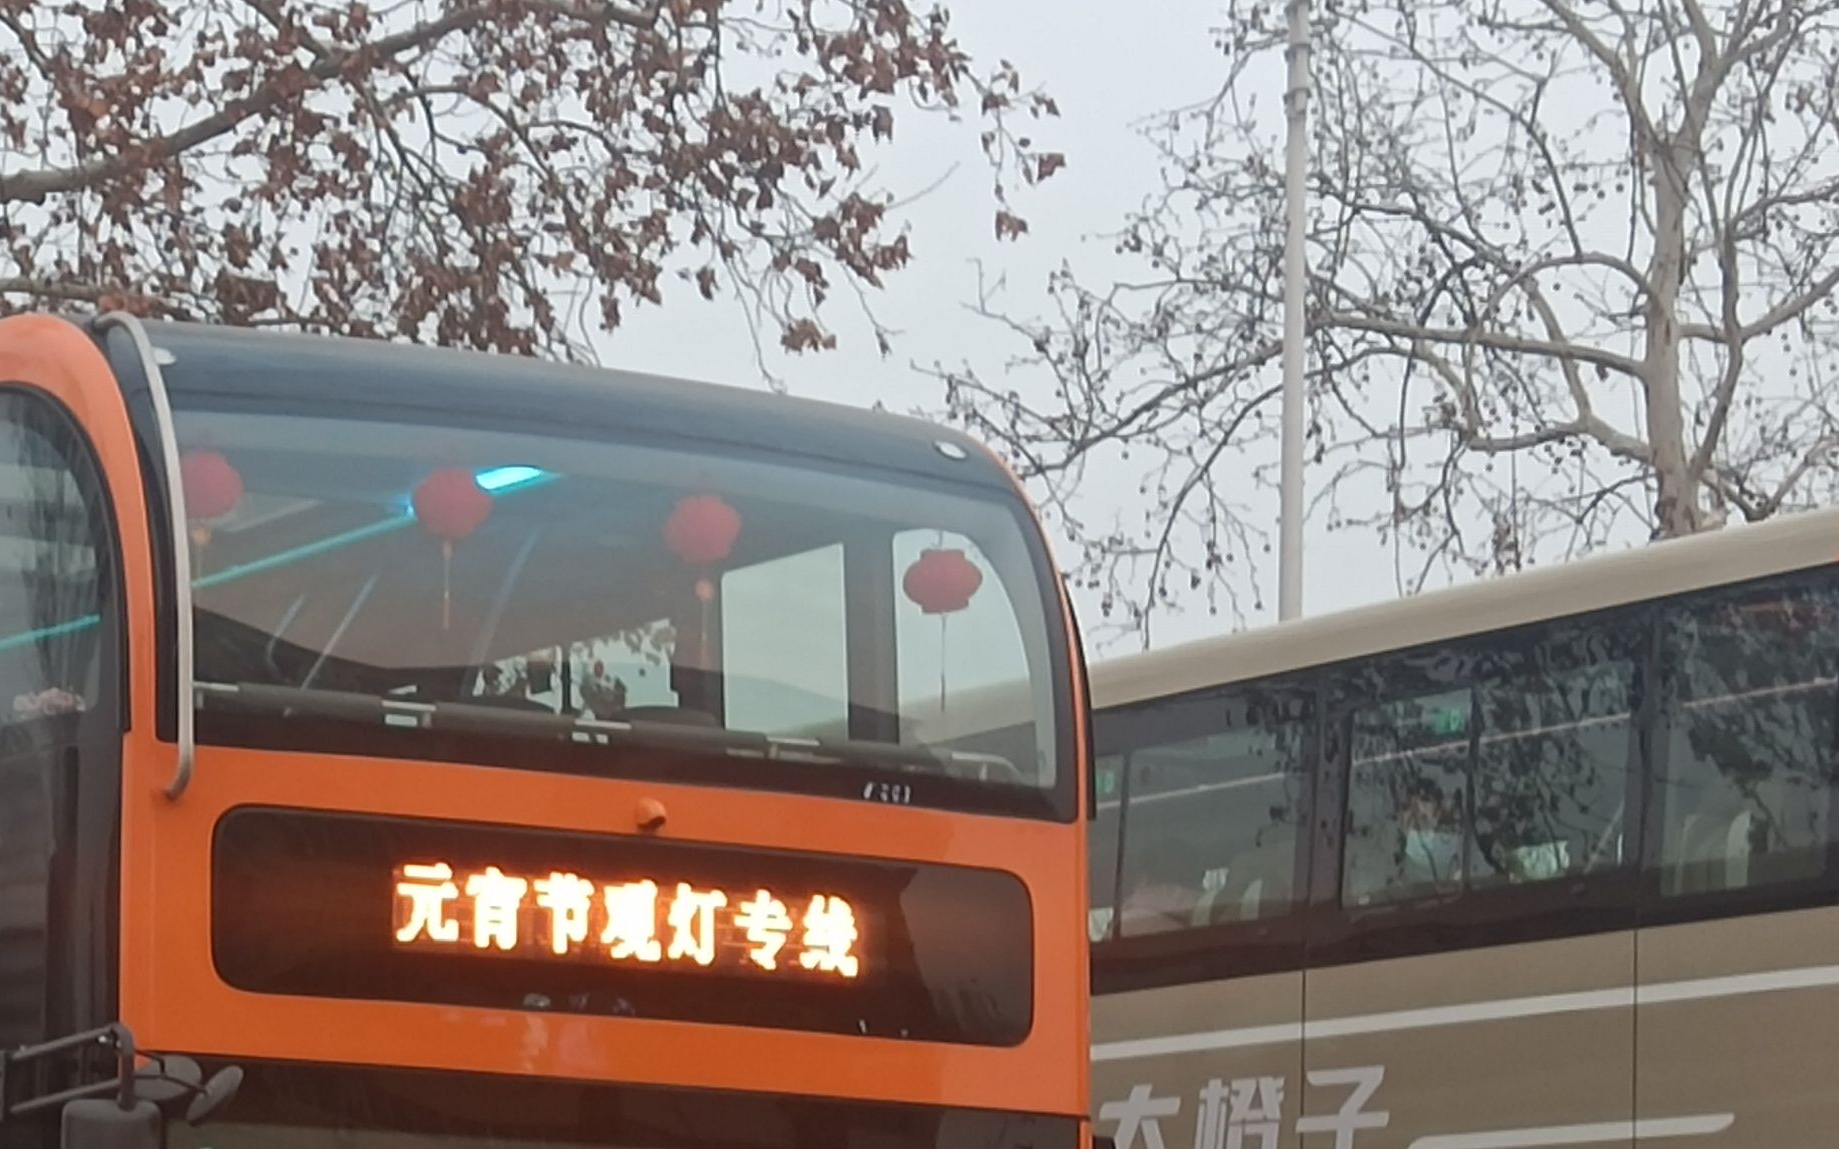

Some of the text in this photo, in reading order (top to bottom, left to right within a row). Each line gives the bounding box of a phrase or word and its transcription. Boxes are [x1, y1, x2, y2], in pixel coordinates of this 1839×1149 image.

[396, 863, 858, 977] 元宵节观灯专线
